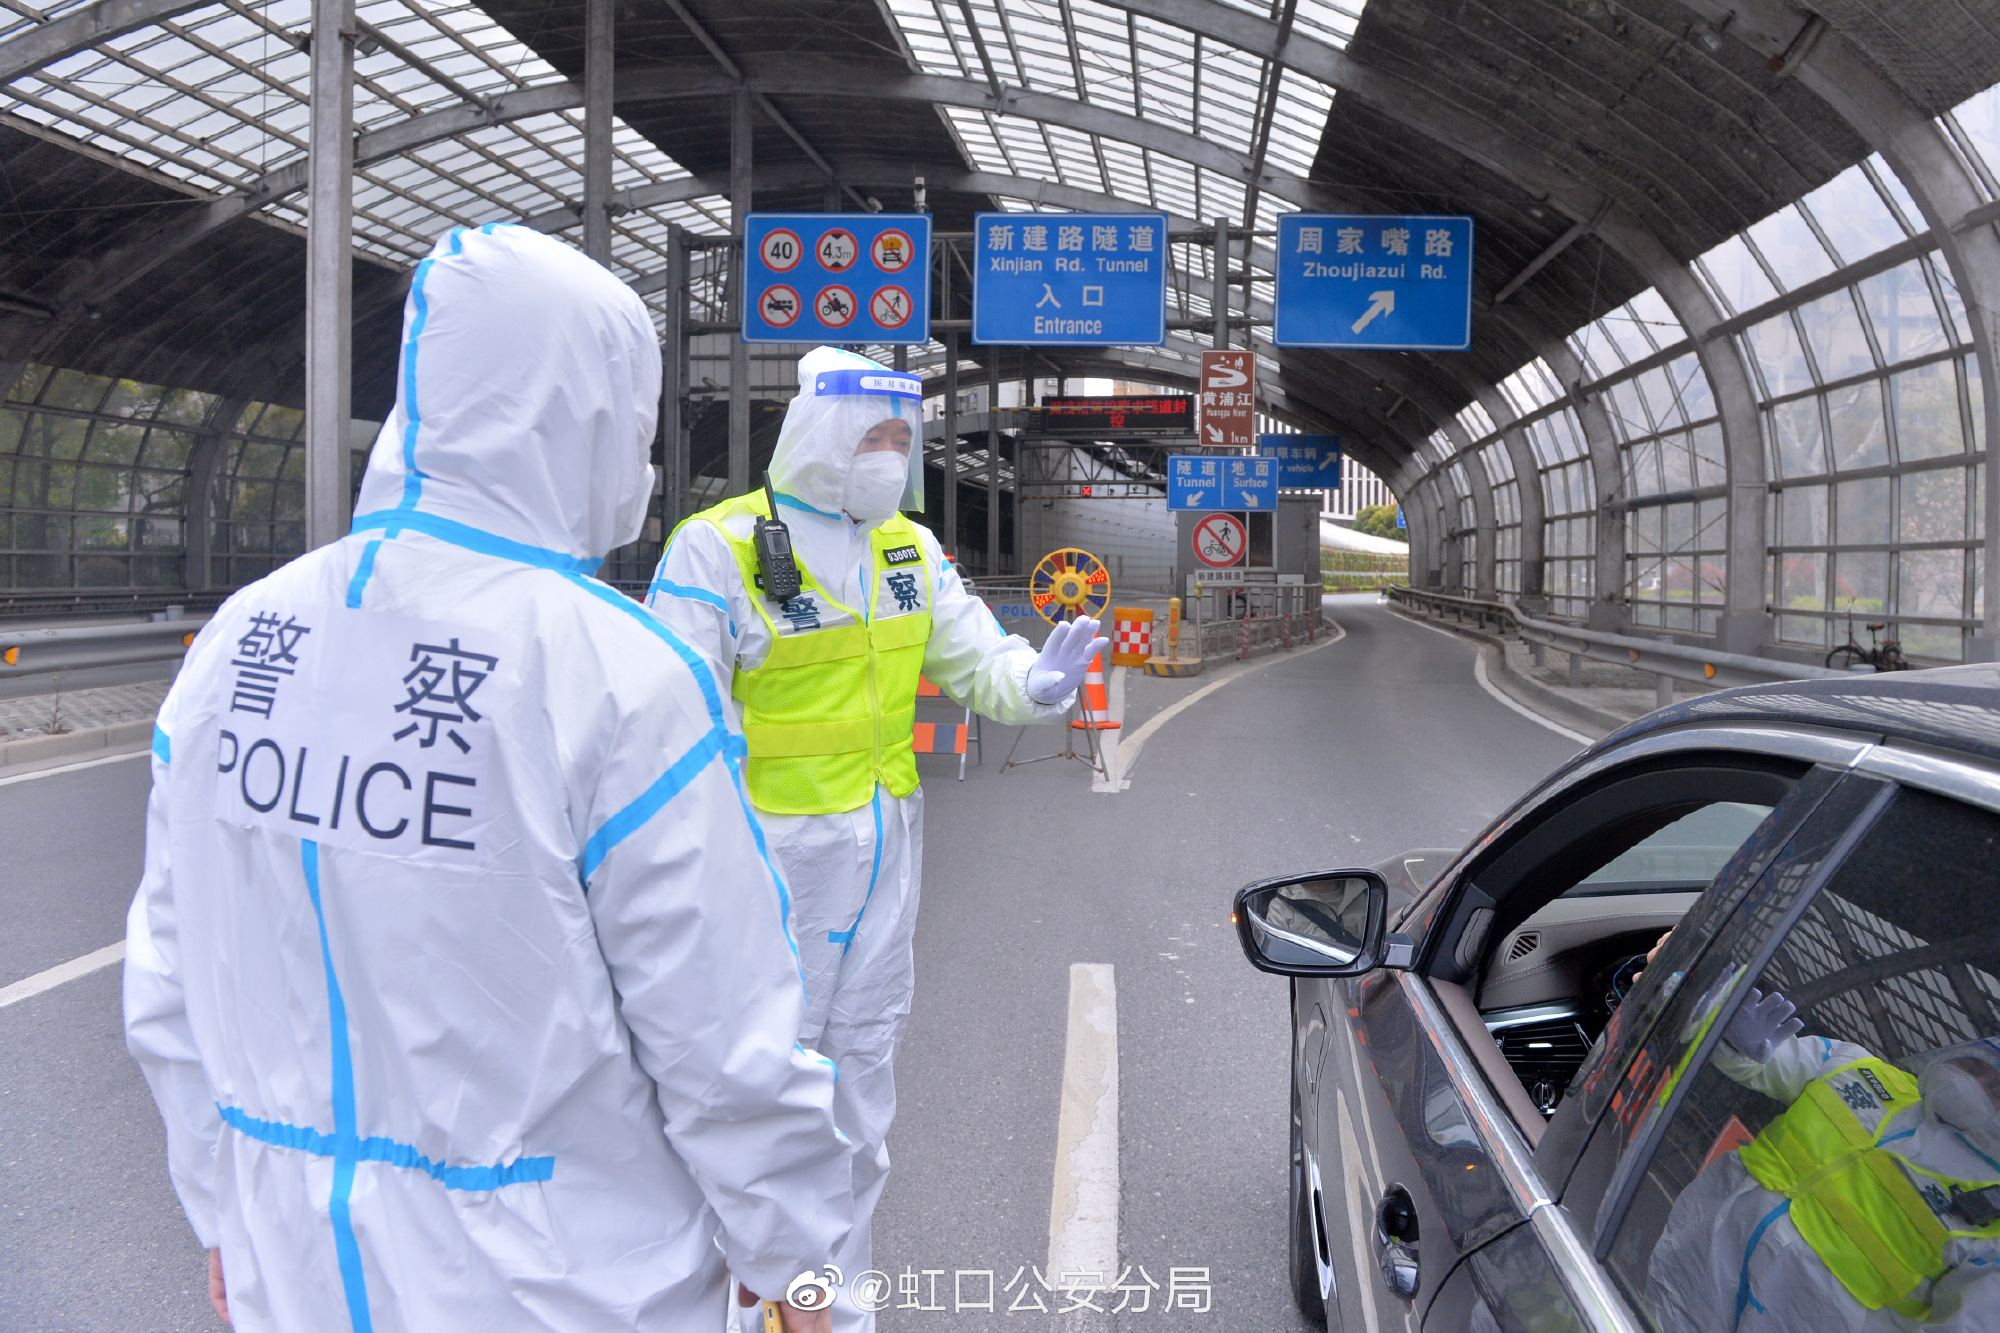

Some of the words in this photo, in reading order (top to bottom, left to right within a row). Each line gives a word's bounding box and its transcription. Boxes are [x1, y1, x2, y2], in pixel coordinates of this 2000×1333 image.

[987, 225, 1154, 252] 新建路隧道
[1296, 227, 1454, 257] 周家嘴路
[770, 241, 793, 260] 40
[822, 242, 852, 260] 4.3m
[990, 257, 1043, 275] Xinjian
[1055, 257, 1085, 272] Rd.
[1095, 257, 1149, 273] Tunnel
[1302, 262, 1405, 281] Zhoujiazui
[1420, 264, 1447, 279] Rd.
[1035, 282, 1104, 309] 入口
[1034, 316, 1102, 335] Entrance
[1202, 390, 1252, 407] 黄浦江
[1206, 408, 1231, 419] Huangpu
[1232, 408, 1248, 418] River
[1230, 431, 1249, 444] 1km
[1176, 459, 1217, 476] 隧道
[1231, 460, 1270, 477] 地面
[1287, 463, 1315, 473] vehicle
[1176, 476, 1216, 488] Tunnel
[1233, 477, 1268, 488] Surface
[887, 548, 918, 562] 036075
[1197, 571, 1243, 581] 新建路隧道
[886, 572, 921, 612] 察
[217, 728, 478, 852] POLICE
